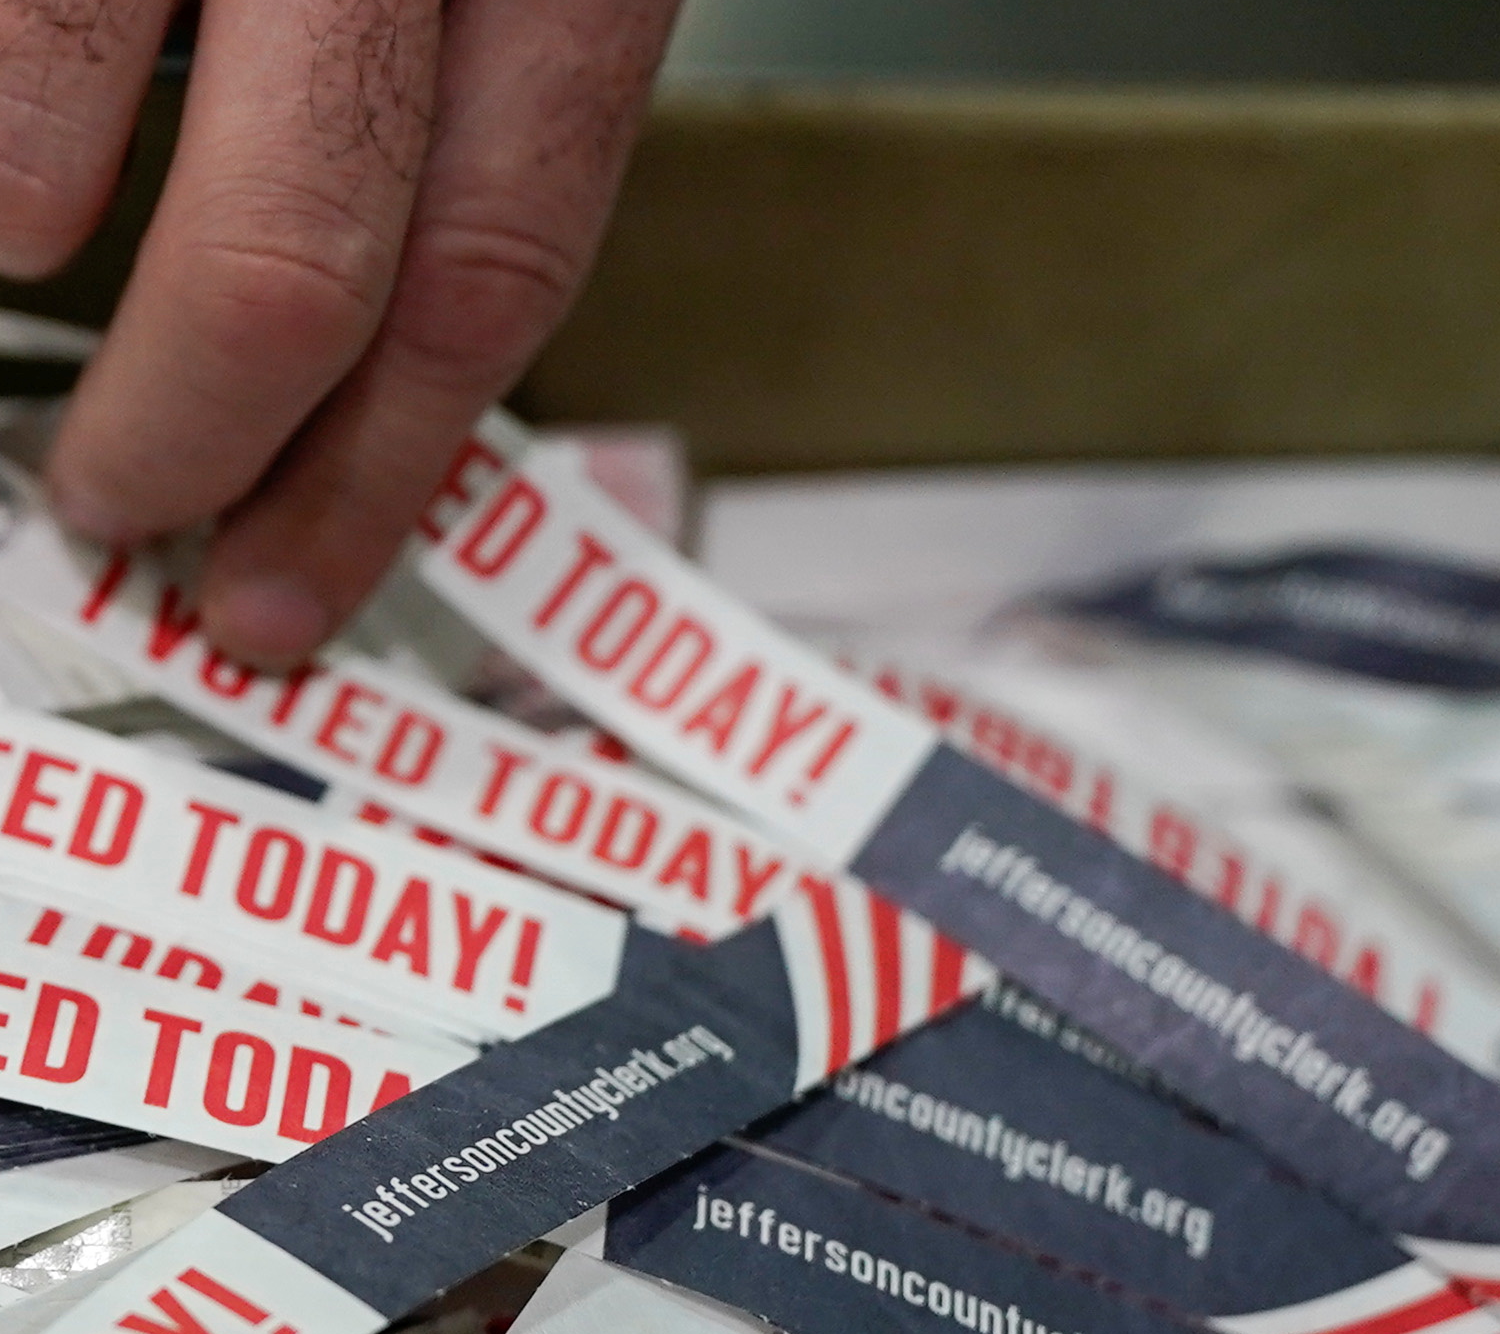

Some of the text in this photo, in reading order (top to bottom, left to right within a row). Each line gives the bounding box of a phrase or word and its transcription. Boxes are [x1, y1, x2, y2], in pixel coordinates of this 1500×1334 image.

[532, 529, 860, 809] TODAY!
[180, 800, 544, 1016] TODAY!
[477, 742, 790, 919] TODAY
[141, 1007, 413, 1144] TOD
[940, 822, 1449, 1179] jeffersoncountyclerk.org
[341, 1023, 736, 1244] jeffersoncountyclerk.org
[834, 1064, 1213, 1258] oncountyclerk.org
